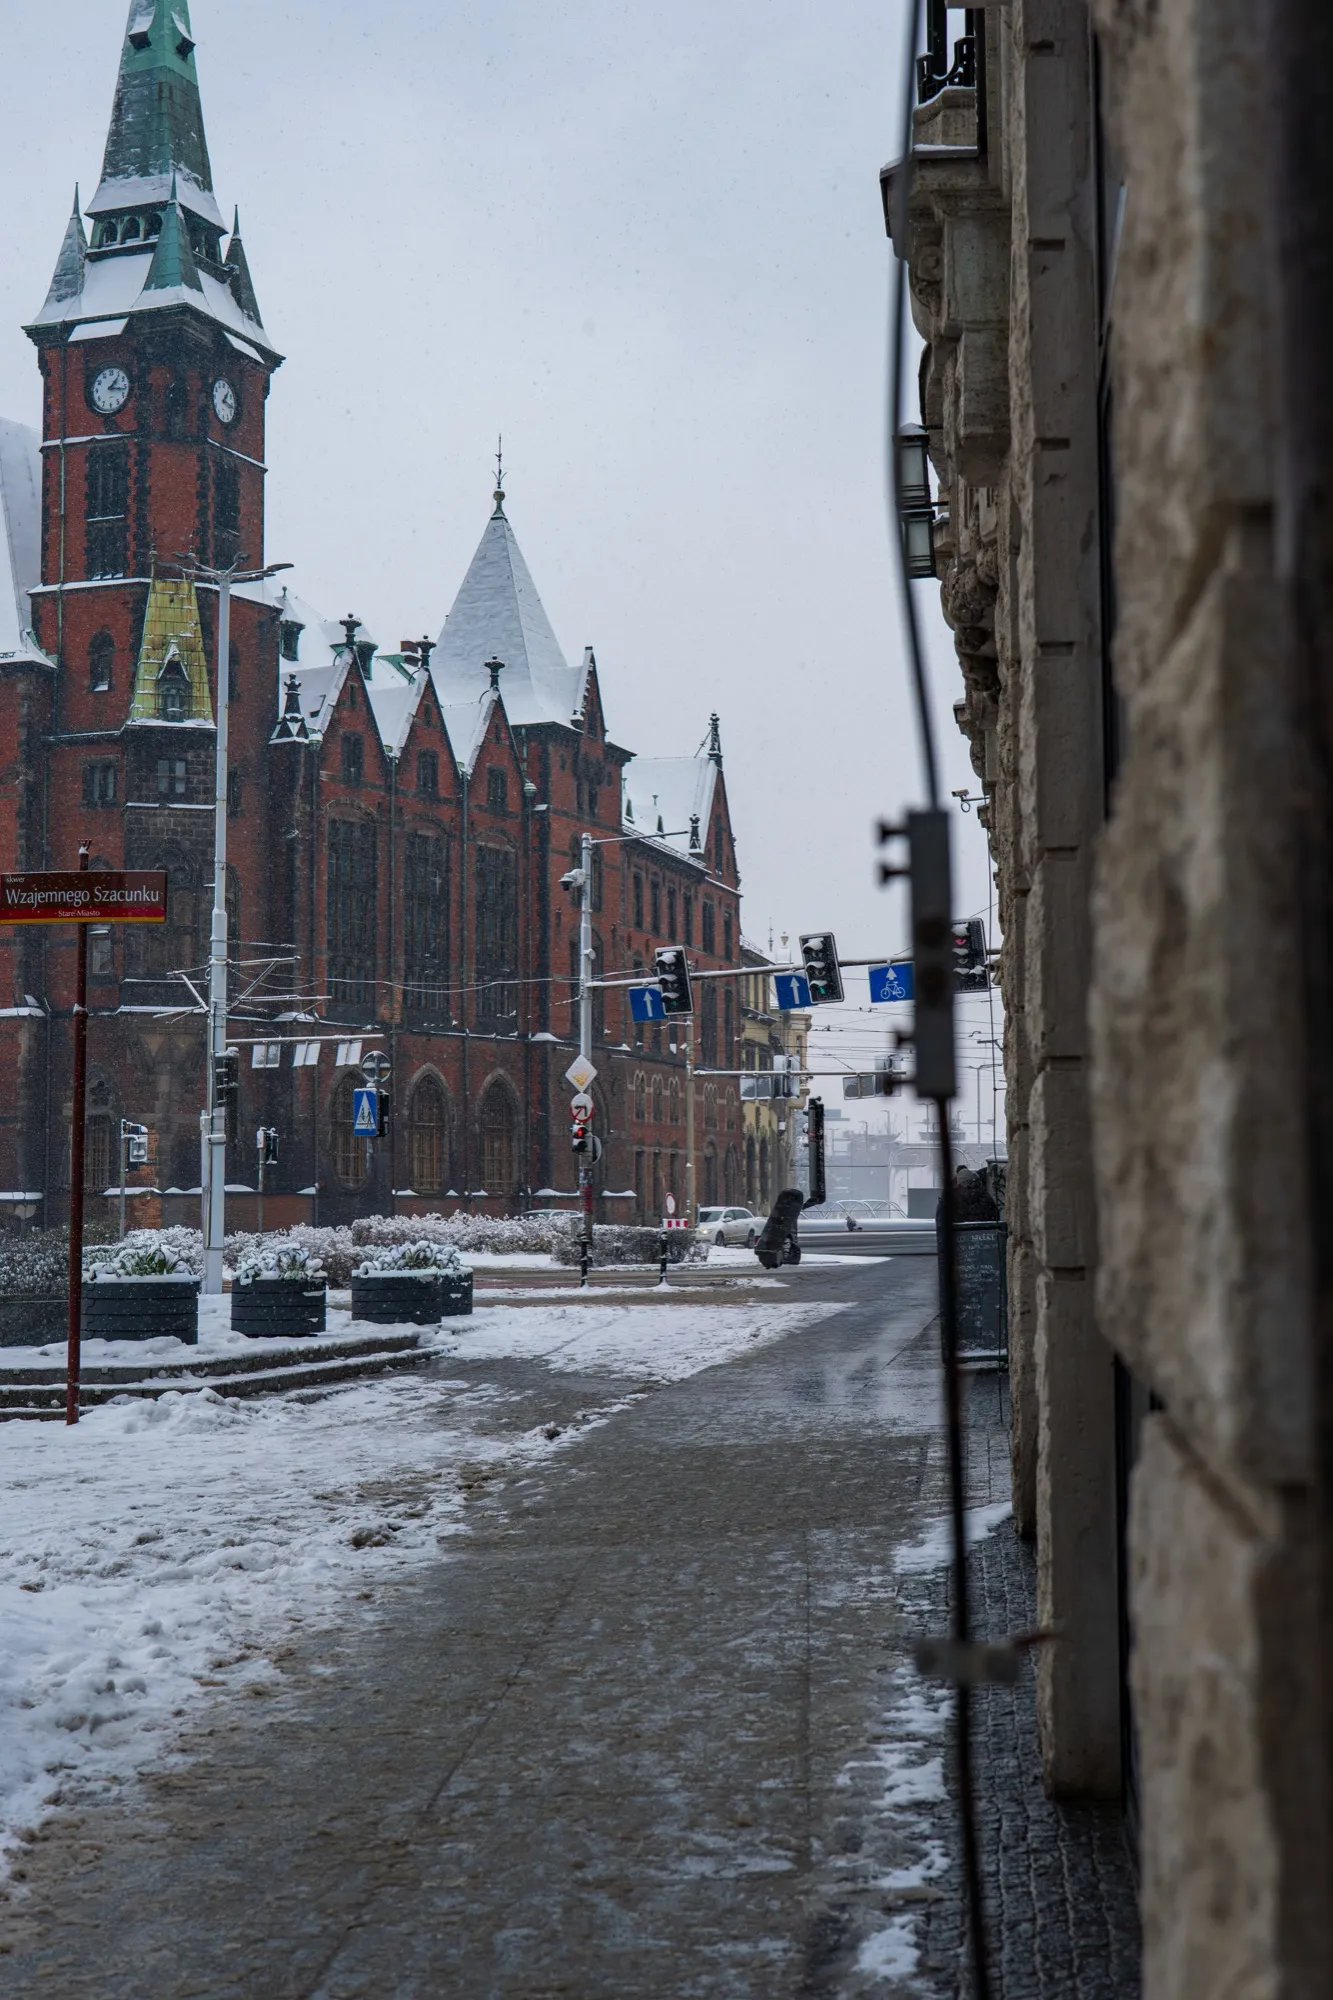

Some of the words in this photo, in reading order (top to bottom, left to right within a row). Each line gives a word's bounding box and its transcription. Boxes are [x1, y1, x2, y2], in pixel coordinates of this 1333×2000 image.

[6, 875, 25, 883] skwer
[5, 888, 90, 907] Wzajemnego
[94, 885, 159, 902] Szacunku
[58, 909, 75, 917] Stare
[77, 909, 100, 917] Miasto
